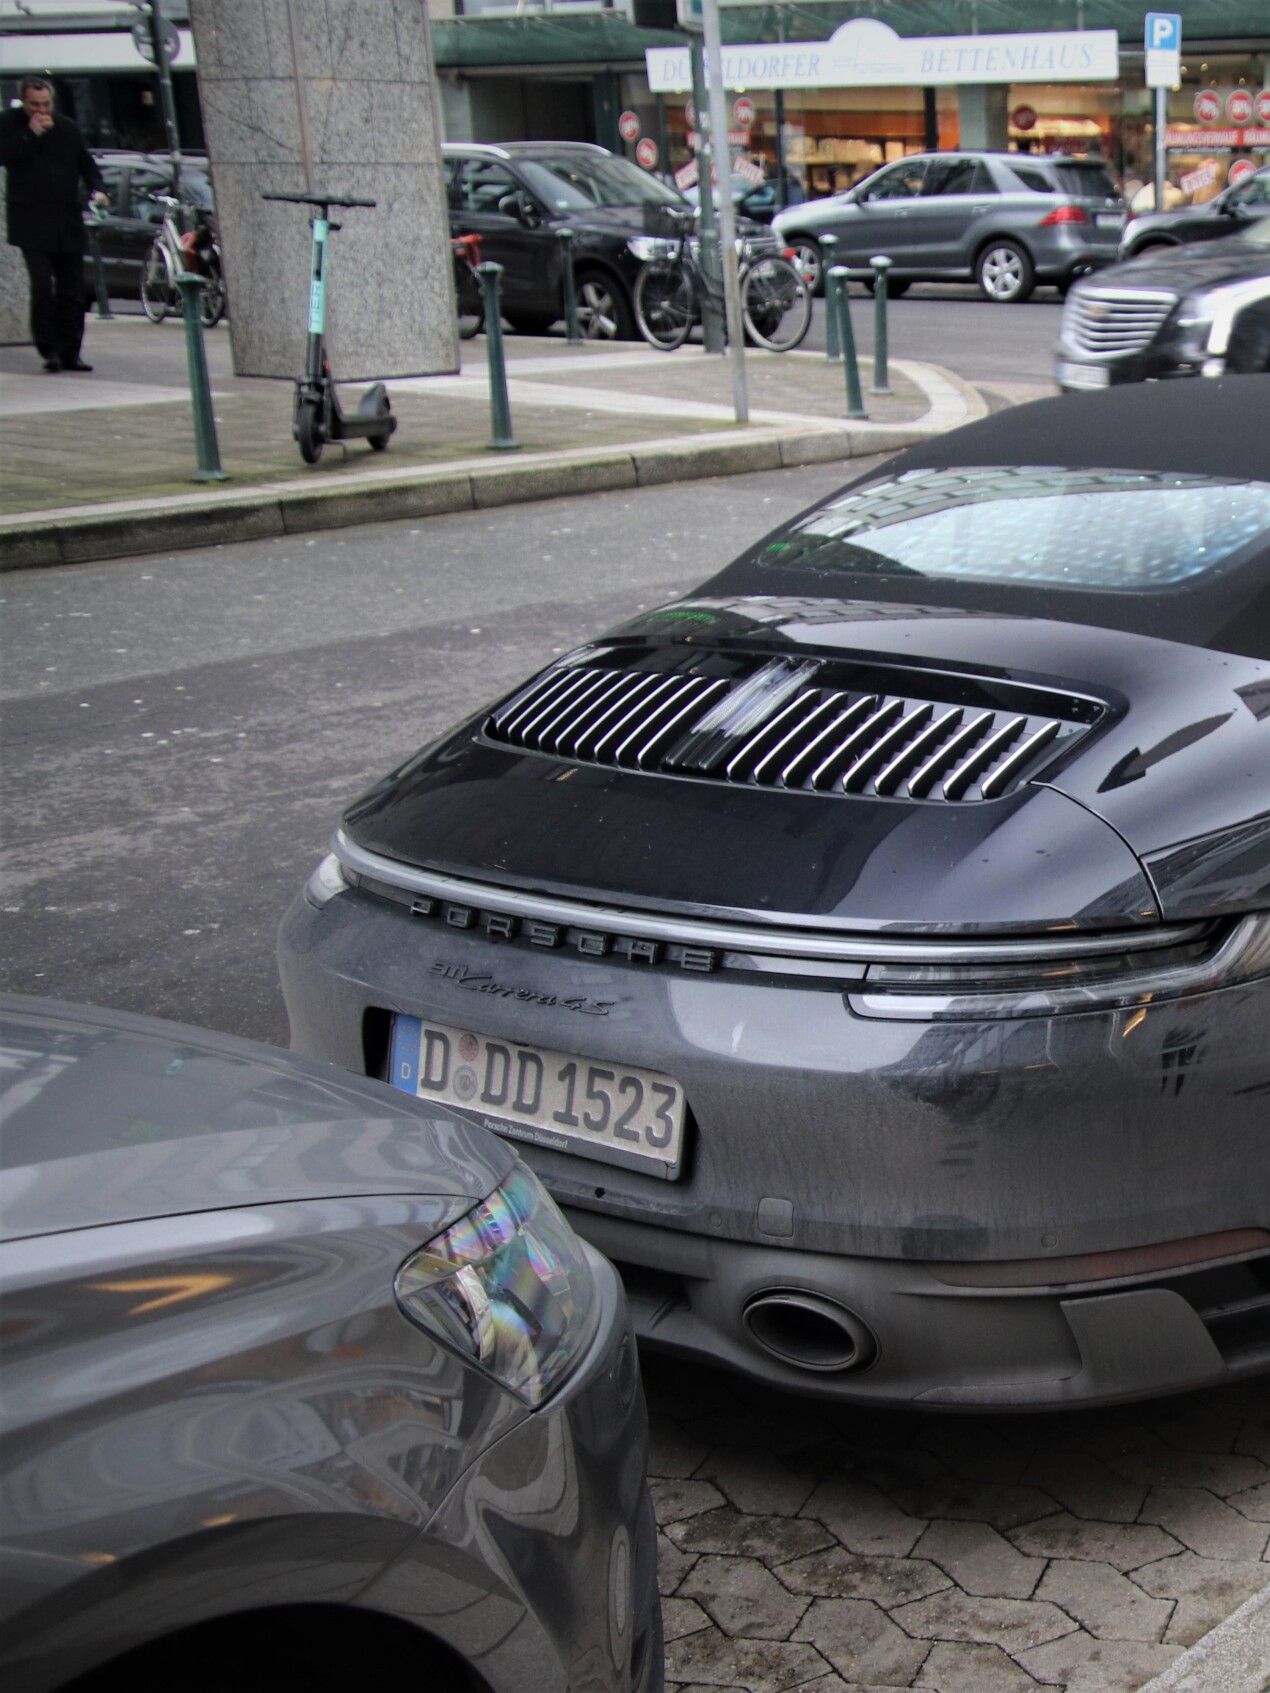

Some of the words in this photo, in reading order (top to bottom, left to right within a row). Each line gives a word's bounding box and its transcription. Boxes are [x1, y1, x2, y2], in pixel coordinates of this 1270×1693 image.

[1153, 18, 1173, 47] P
[663, 53, 821, 81] DÜLDORFER
[920, 43, 1093, 73] BETTENHAUS
[308, 283, 320, 330] TIER
[410, 898, 715, 973] PORSCHE
[428, 960, 468, 981] 911
[456, 972, 556, 1007] Carrera
[559, 997, 615, 1016] 4S
[401, 1062, 411, 1080] D
[420, 1029, 450, 1092] D
[480, 1042, 544, 1115] DD
[553, 1062, 677, 1148] 1523
[484, 1118, 508, 1133] Porsche
[508, 1125, 534, 1140] Zentrum
[534, 1132, 568, 1149] Düsseldorf
